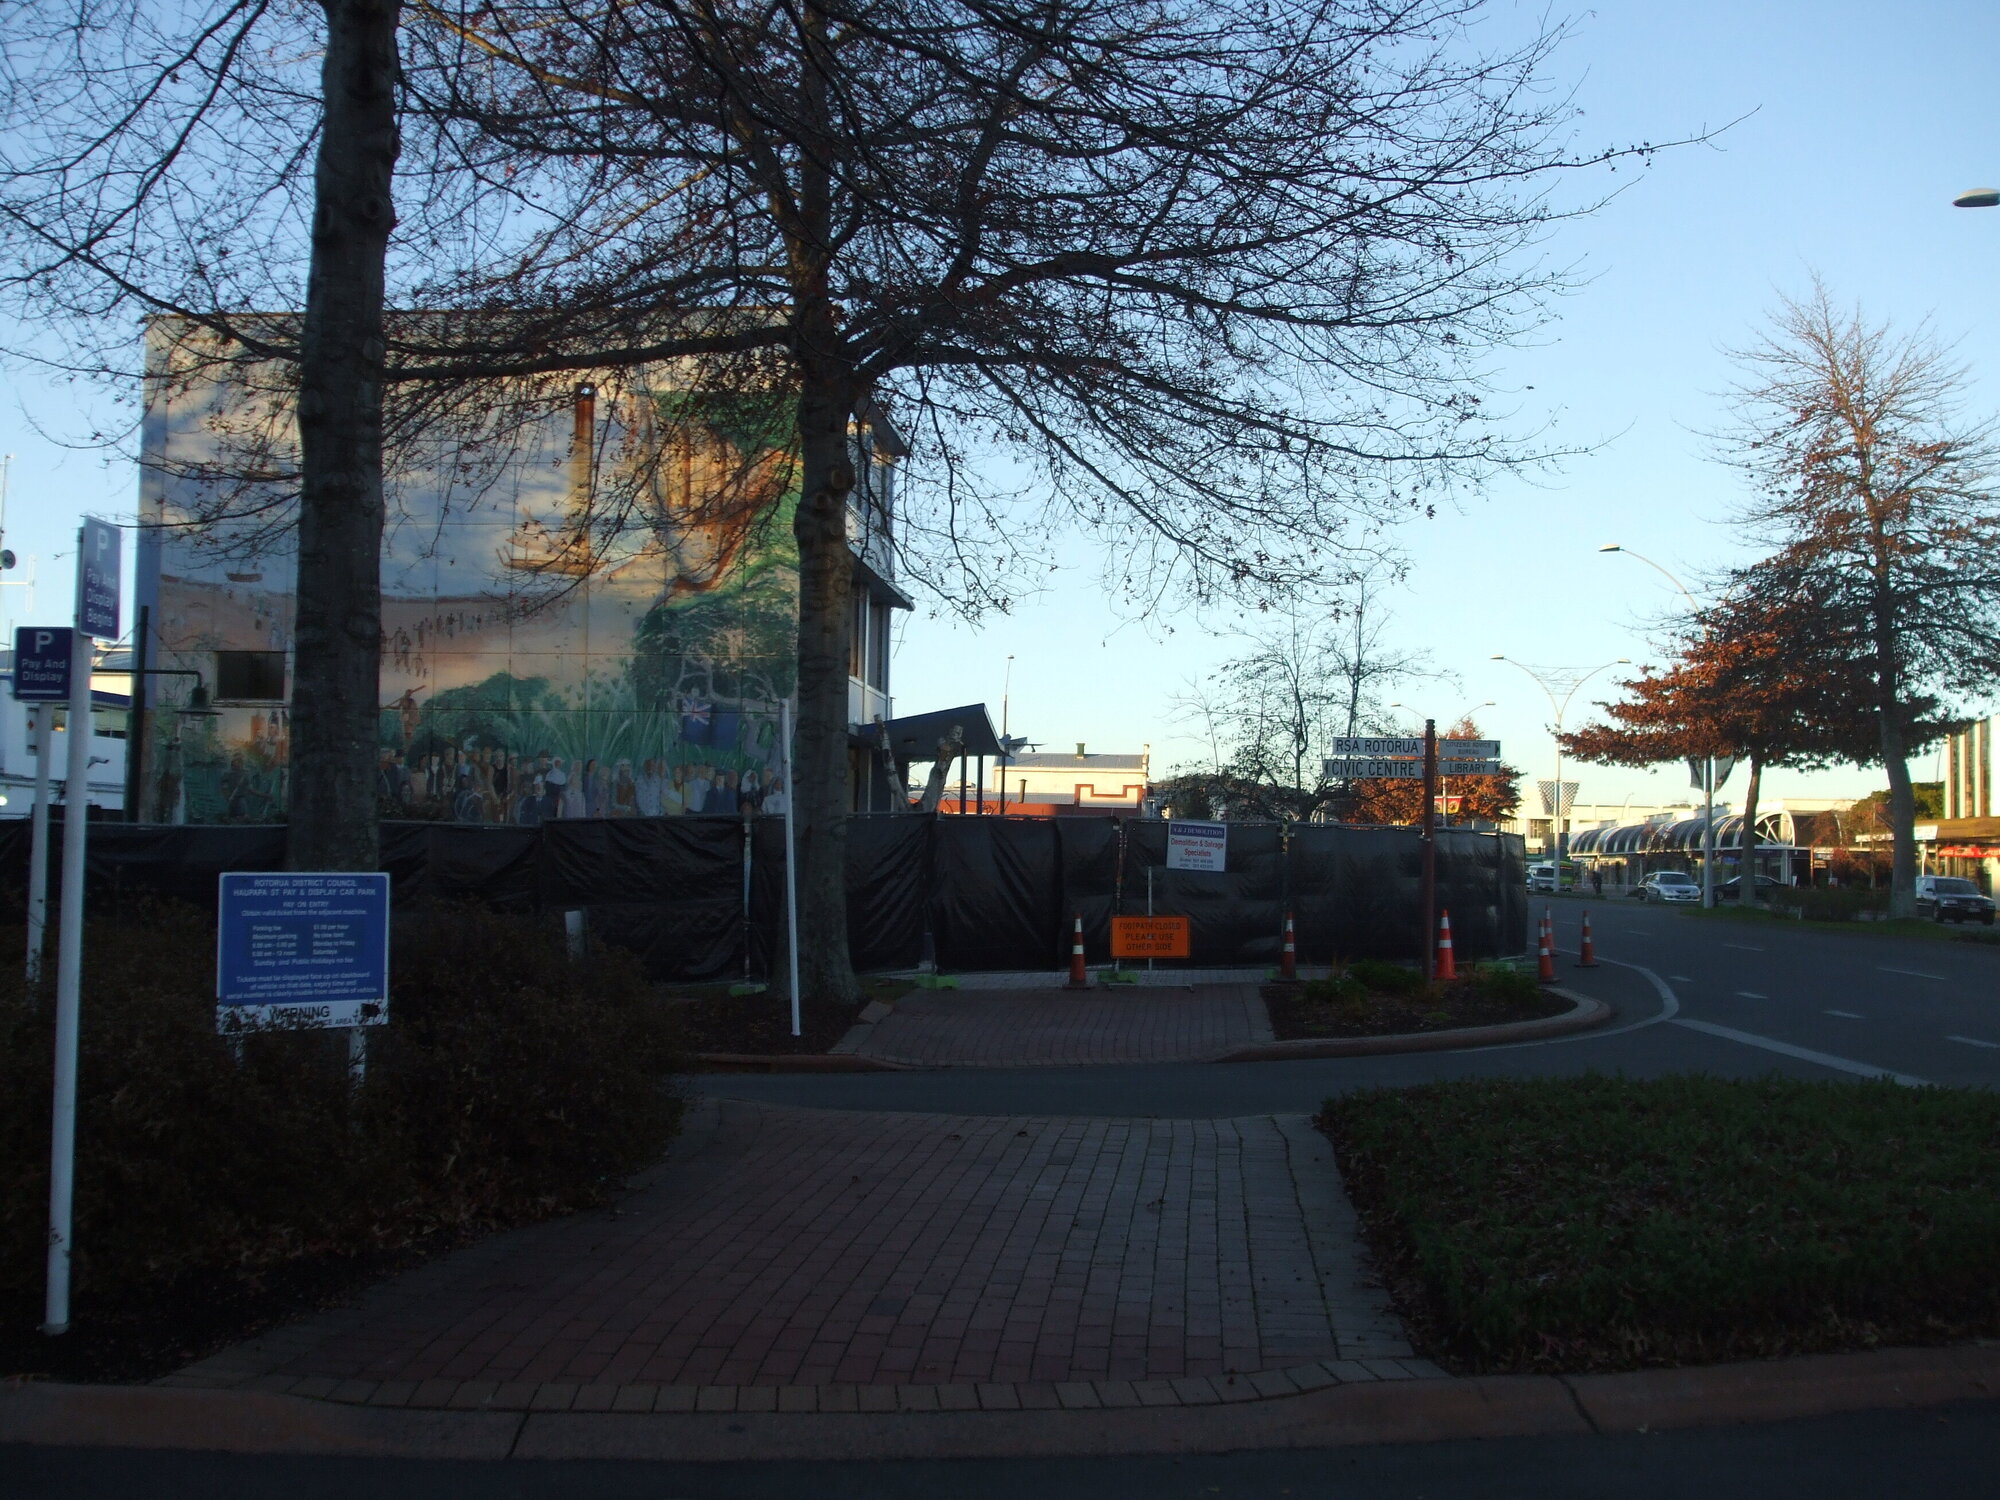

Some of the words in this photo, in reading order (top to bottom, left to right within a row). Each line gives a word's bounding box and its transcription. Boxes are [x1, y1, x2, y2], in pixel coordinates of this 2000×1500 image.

[96, 528, 109, 560] P
[86, 568, 100, 587] Pay
[102, 575, 116, 589] And
[86, 588, 114, 610] Display
[87, 610, 113, 627] Begins
[34, 631, 54, 654] P
[22, 658, 41, 670] Pay
[44, 658, 66, 669] And
[22, 670, 63, 683] Display
[1336, 739, 1360, 752] RSA
[1364, 740, 1419, 754] ROTORUA
[1332, 761, 1364, 776] CIVIC
[1368, 762, 1415, 776] CENTRE
[1449, 763, 1486, 773] LIBRARY
[1188, 828, 1223, 836] DEMOLITION
[1171, 838, 1198, 847] Demolition
[1205, 841, 1223, 850] Salvage
[1184, 849, 1211, 857] Specialists
[1119, 922, 1153, 930] FOOTPATH
[1155, 922, 1180, 930] CLOSED
[269, 1005, 330, 1020] WARNING
